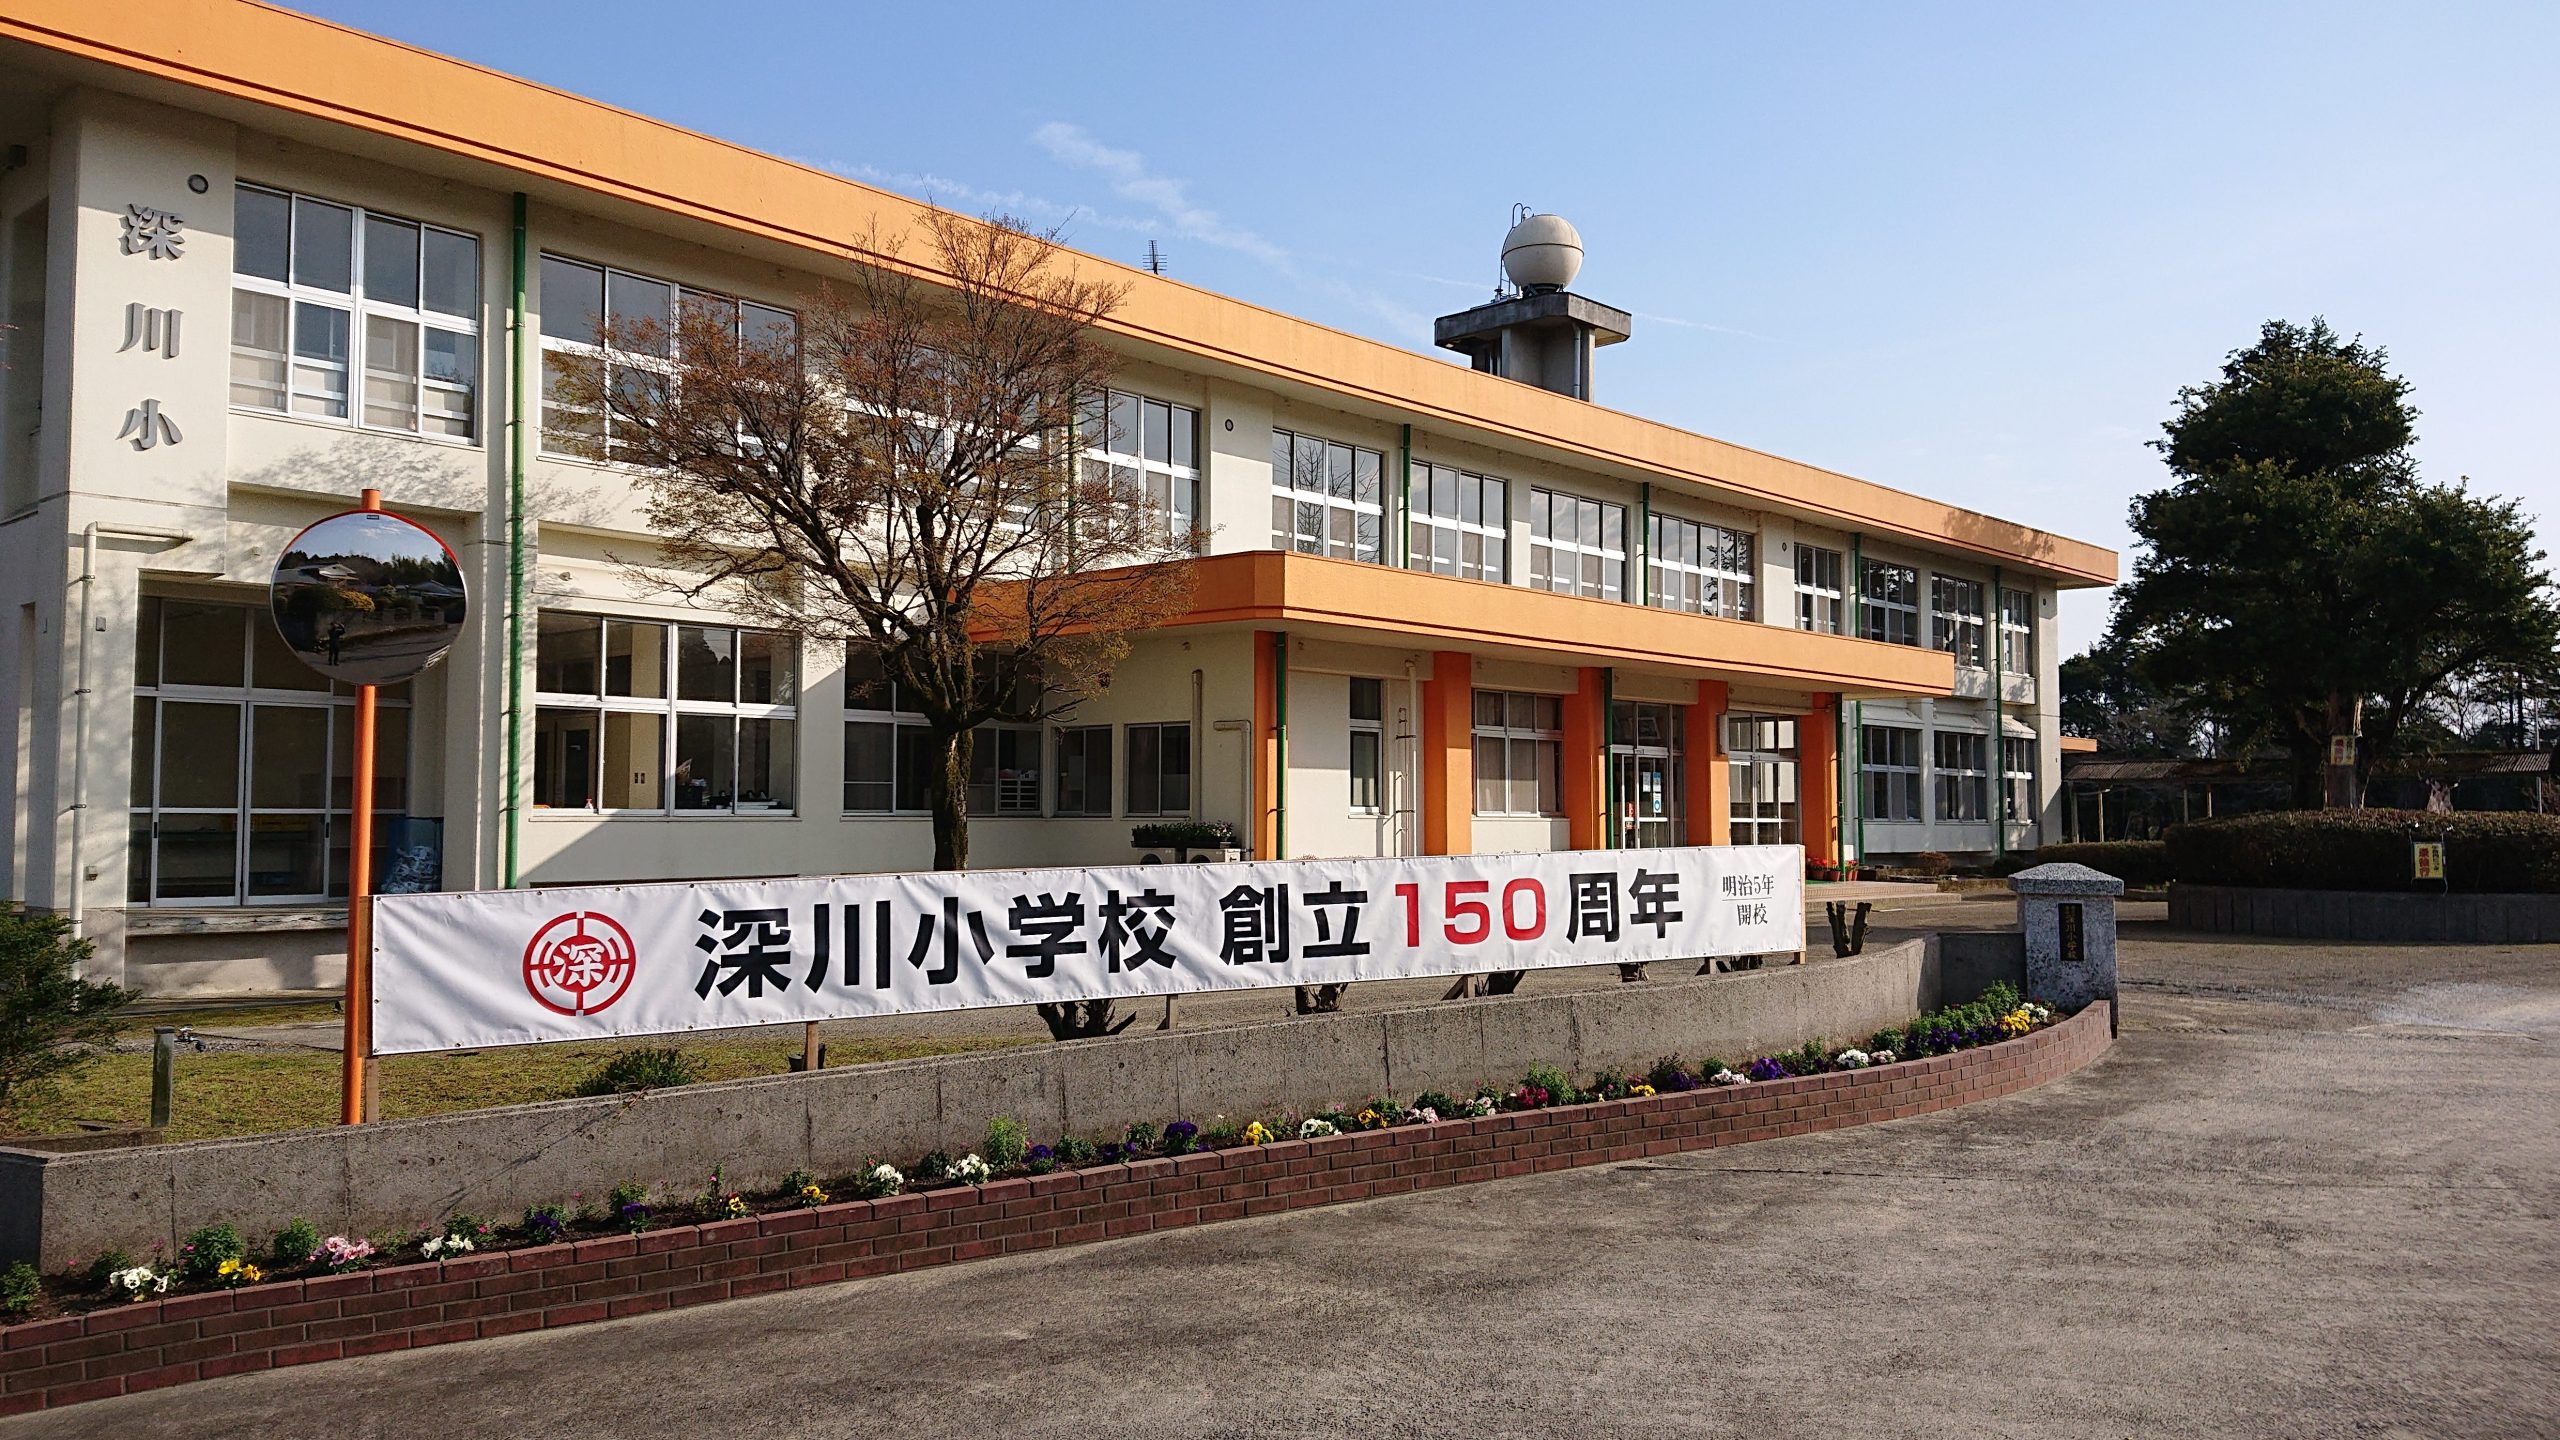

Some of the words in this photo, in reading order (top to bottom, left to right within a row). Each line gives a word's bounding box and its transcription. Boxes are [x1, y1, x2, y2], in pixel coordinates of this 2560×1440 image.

[115, 203, 186, 451] 深川小
[1722, 874, 1775, 897] 明治5年
[1736, 903, 1768, 926] 開校
[552, 943, 605, 988] 深
[694, 888, 1177, 1001] 深川小学校
